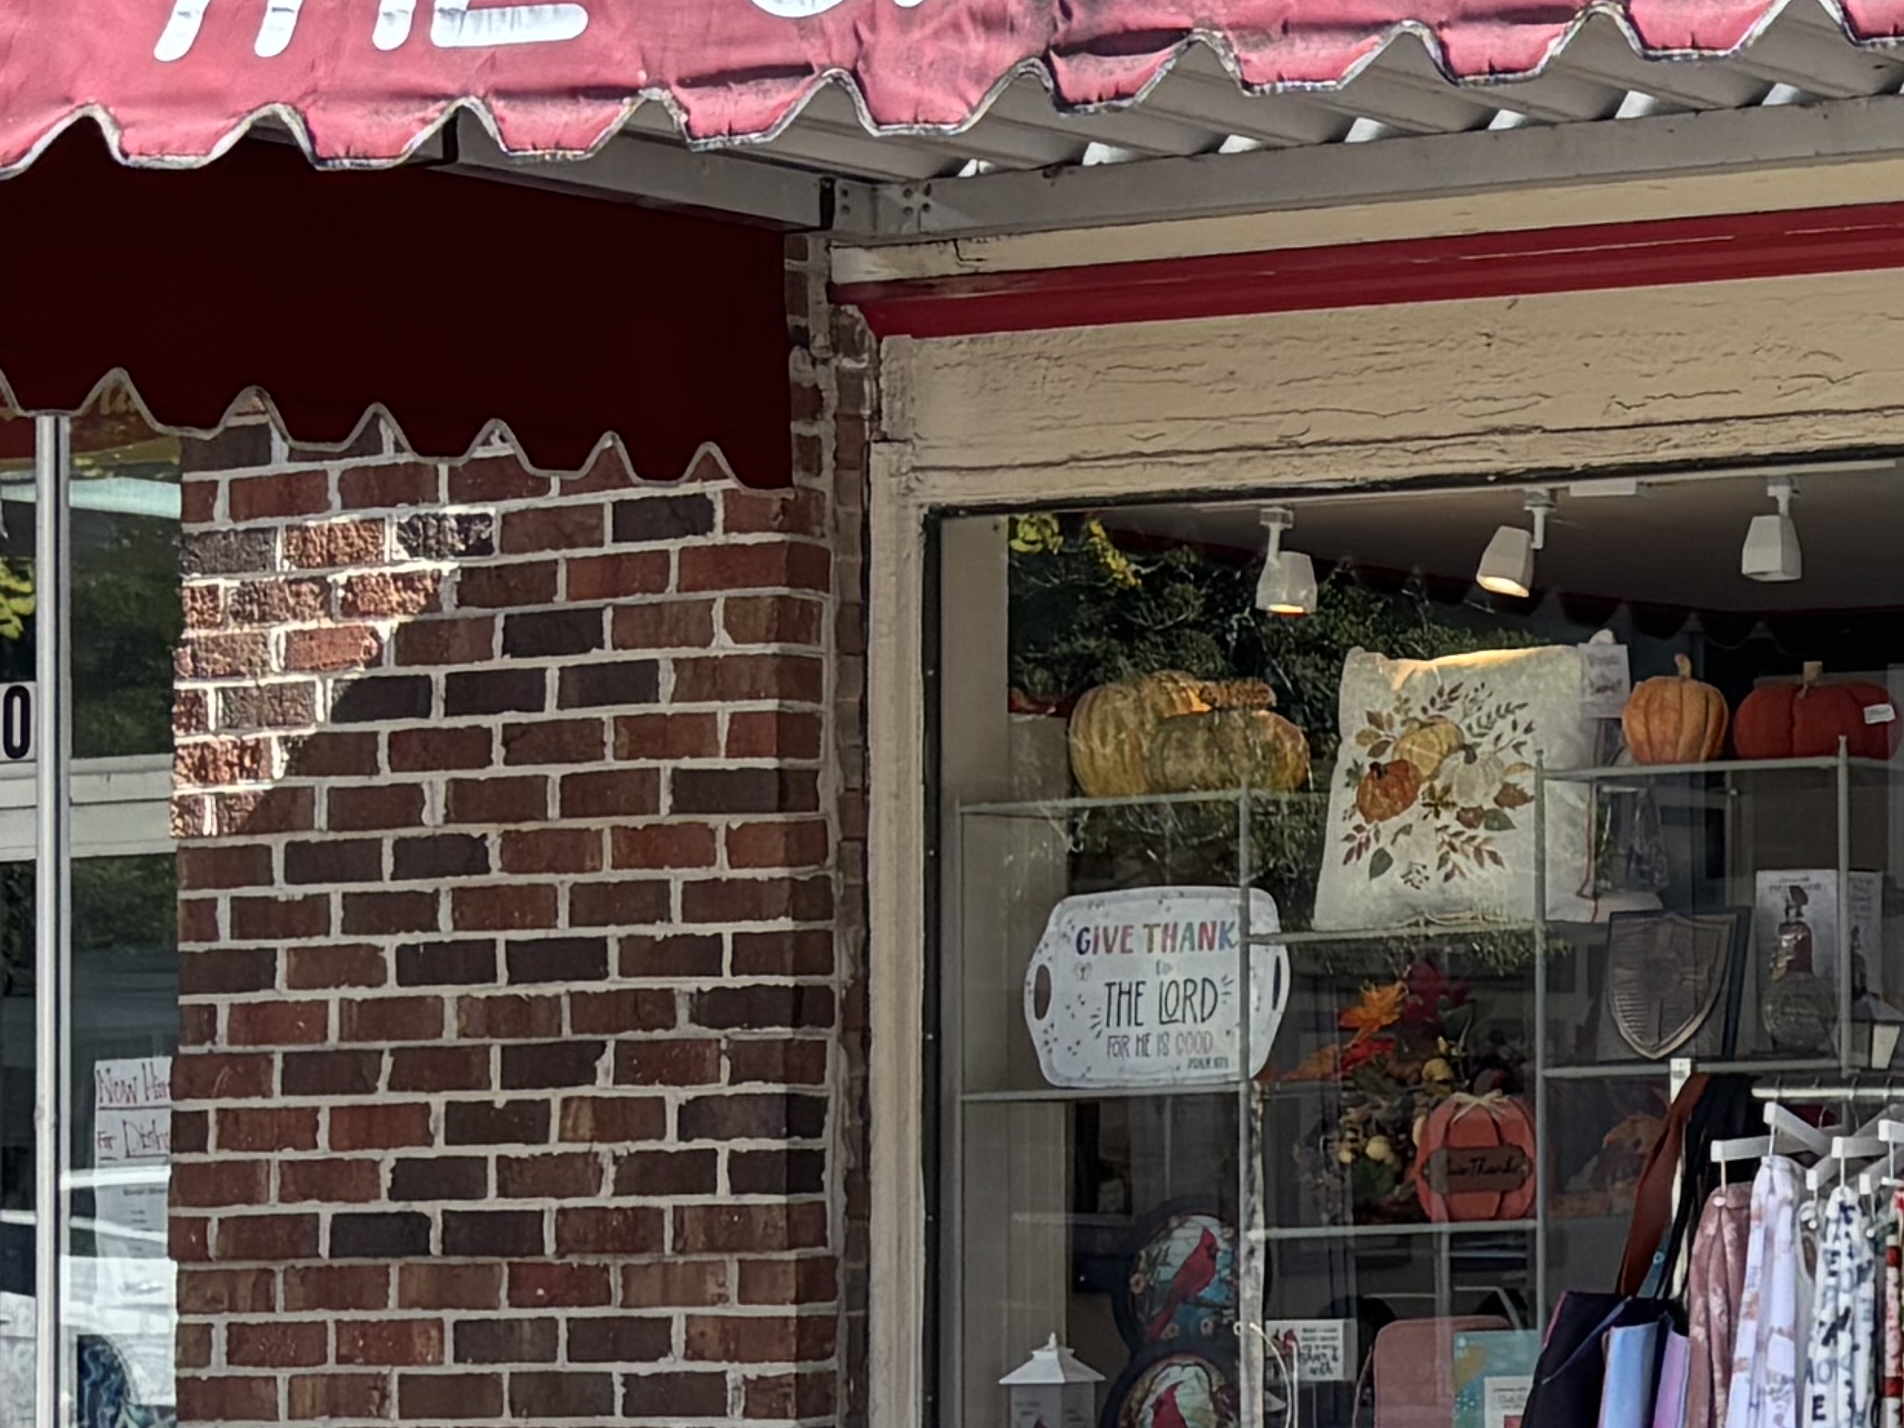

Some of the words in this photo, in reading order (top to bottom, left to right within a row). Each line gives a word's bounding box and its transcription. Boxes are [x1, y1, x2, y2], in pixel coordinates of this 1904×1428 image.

[1076, 925, 1134, 956] GIVE
[1143, 920, 1238, 954] THANK
[1104, 979, 1147, 1028] THE
[1159, 977, 1219, 1025] LORD
[1107, 1034, 1130, 1059] FOR
[1135, 1032, 1151, 1058] HE
[1156, 1031, 1170, 1057] IS
